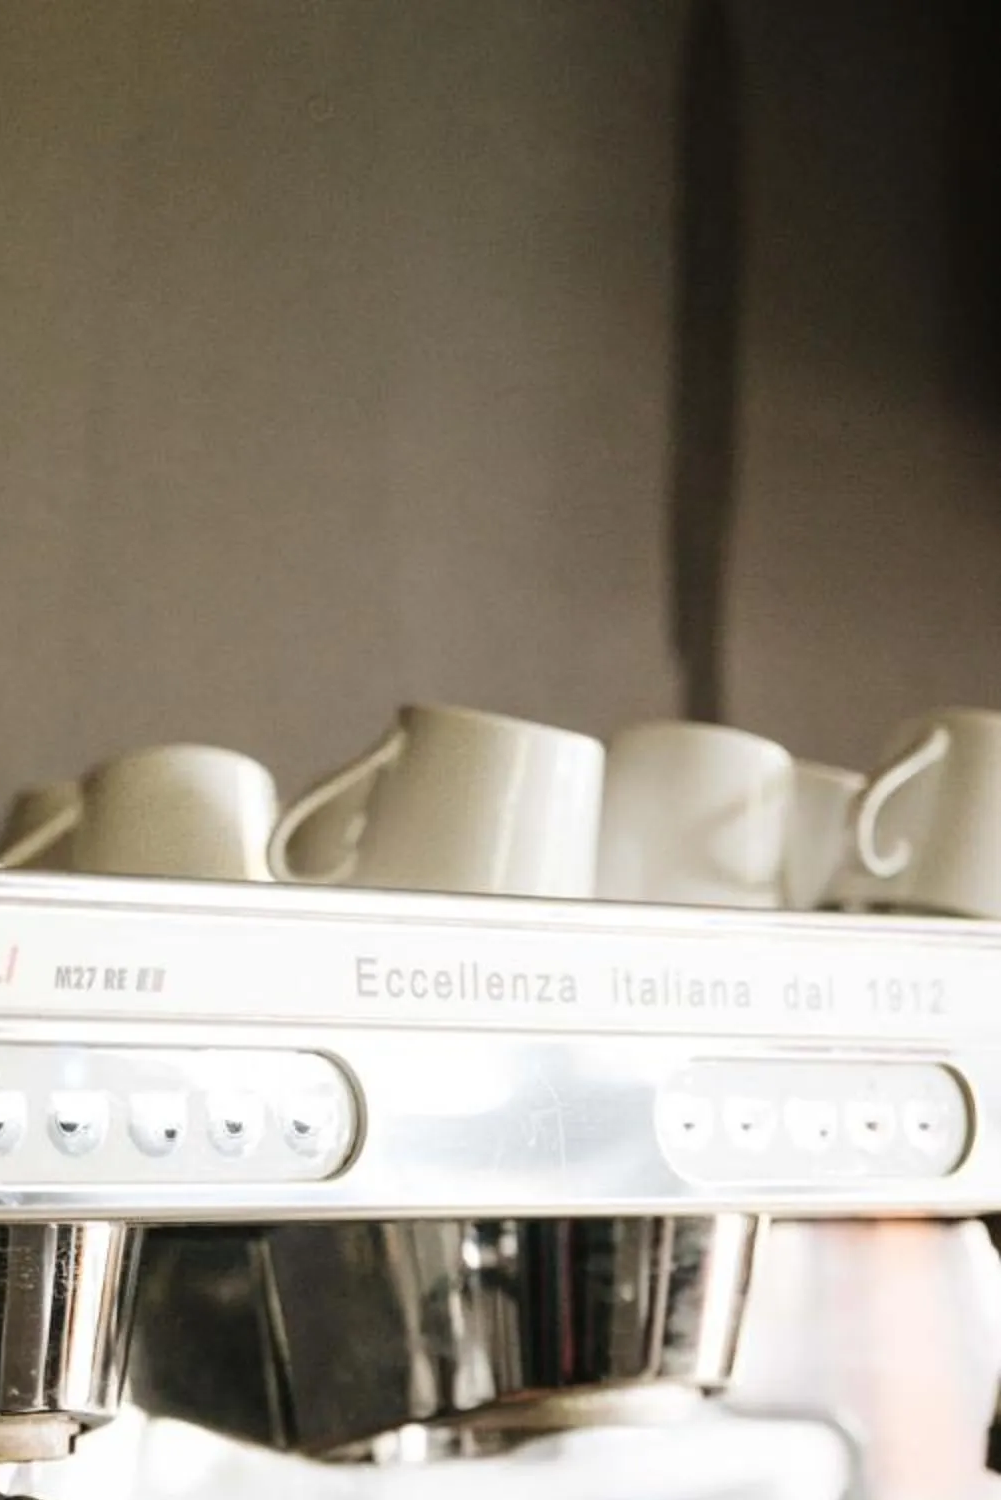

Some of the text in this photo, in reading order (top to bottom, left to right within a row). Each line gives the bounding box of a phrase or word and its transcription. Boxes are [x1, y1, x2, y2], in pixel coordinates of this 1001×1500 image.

[54, 965, 98, 991] M27
[103, 967, 128, 991] RE
[355, 956, 947, 1015] Eccellenza italiana dal 1912
